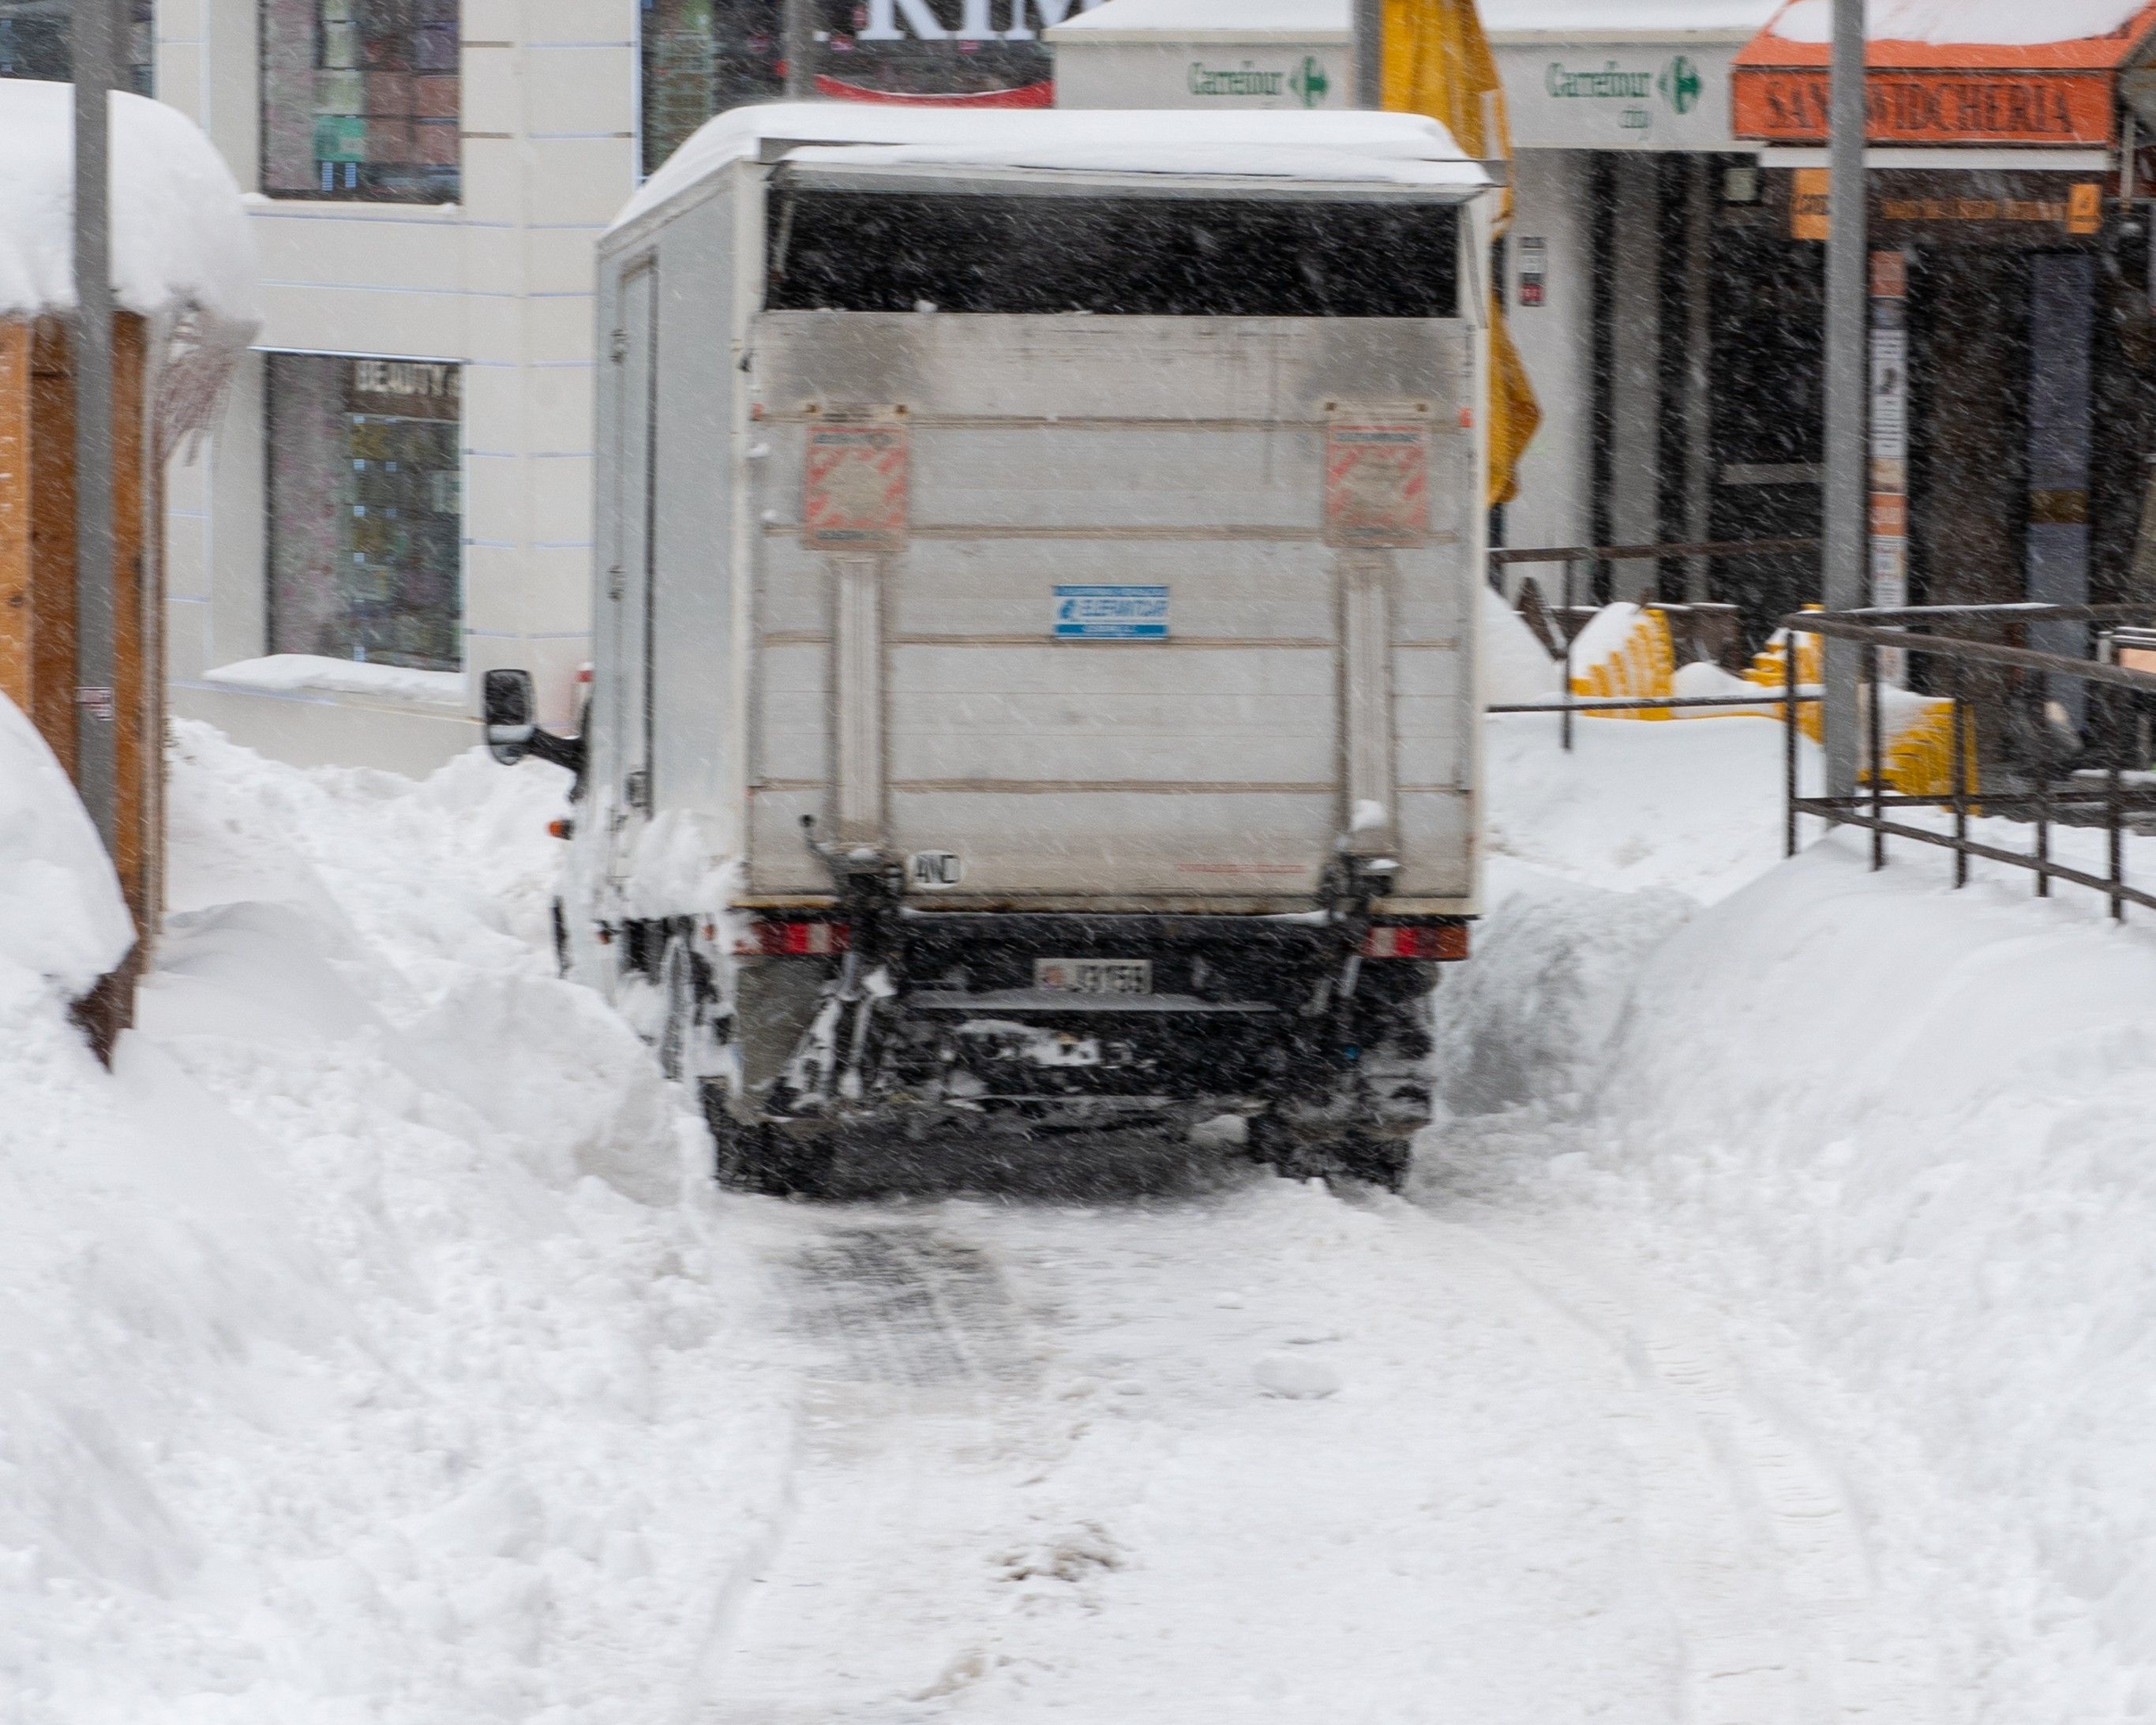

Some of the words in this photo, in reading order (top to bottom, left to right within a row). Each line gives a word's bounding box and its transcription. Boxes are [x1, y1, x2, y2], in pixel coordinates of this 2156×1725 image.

[1189, 60, 1284, 96] Carrefour
[1547, 60, 1650, 97] Carrefour
[916, 854, 960, 883] AND
